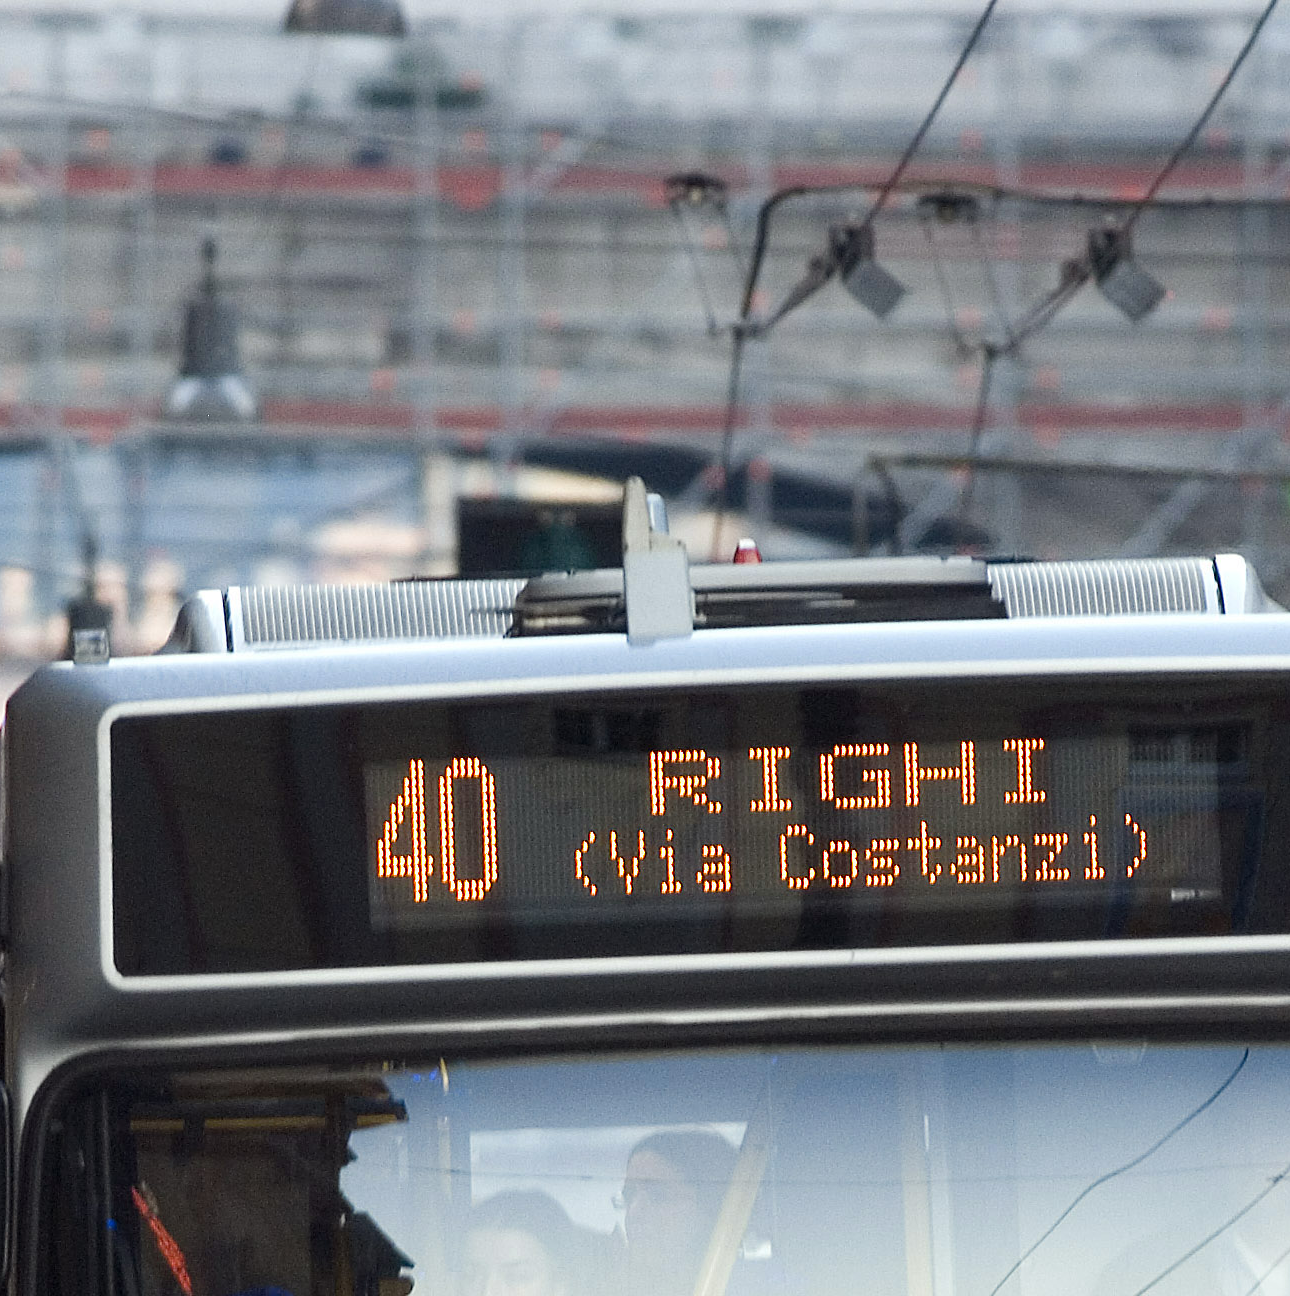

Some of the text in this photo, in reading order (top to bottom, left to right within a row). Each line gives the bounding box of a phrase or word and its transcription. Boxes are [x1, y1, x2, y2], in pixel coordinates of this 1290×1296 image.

[649, 738, 1046, 816] RIGHI
[377, 757, 498, 902] 40
[575, 813, 1146, 896] (Via Costanzi)
